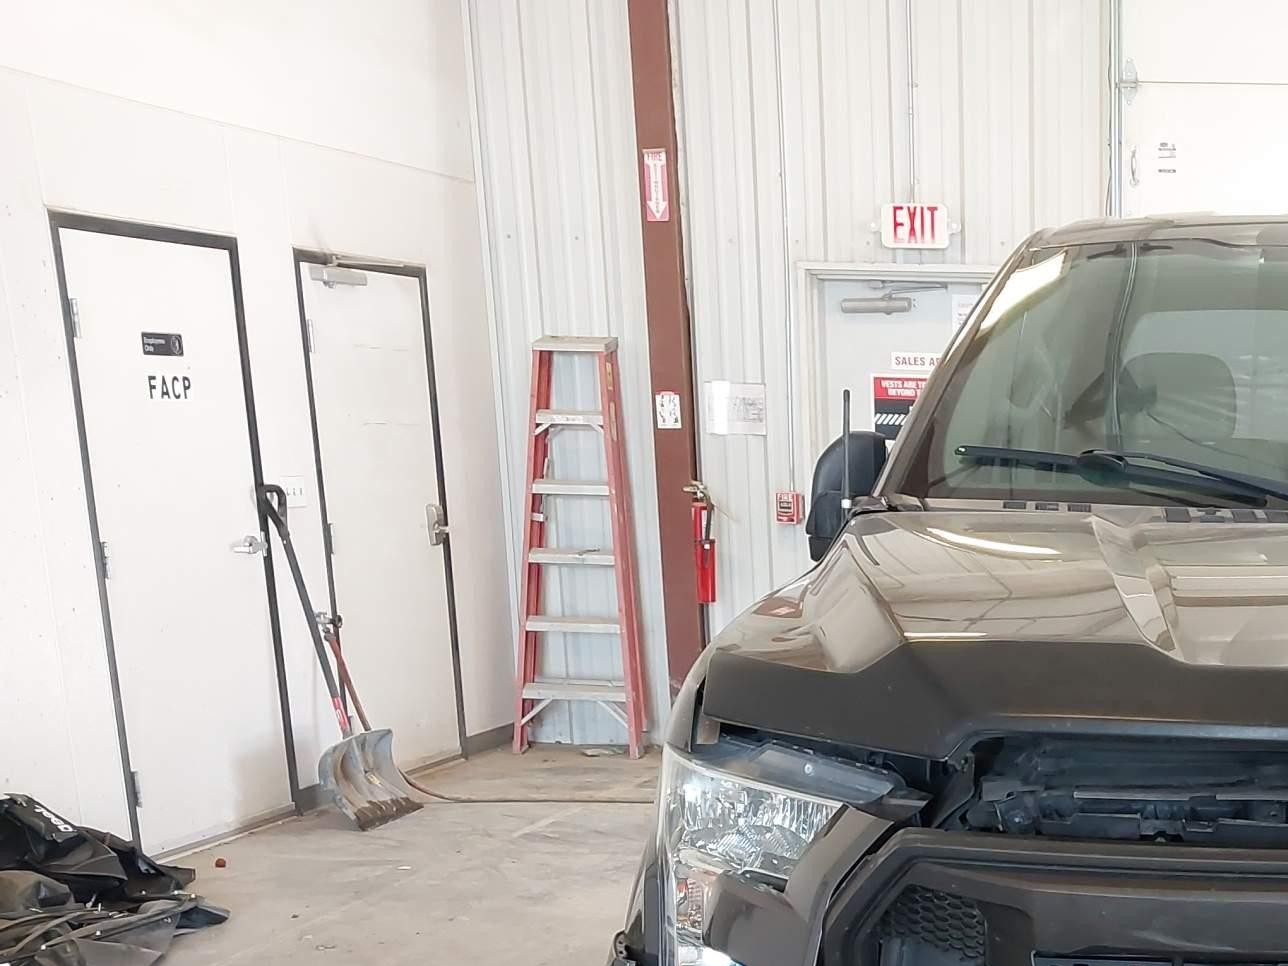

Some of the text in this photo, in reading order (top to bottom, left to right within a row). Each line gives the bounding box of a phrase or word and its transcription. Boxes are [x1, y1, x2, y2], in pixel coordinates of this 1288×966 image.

[892, 206, 938, 244] EXIT
[895, 356, 926, 366] SALES
[148, 375, 191, 399] FACP
